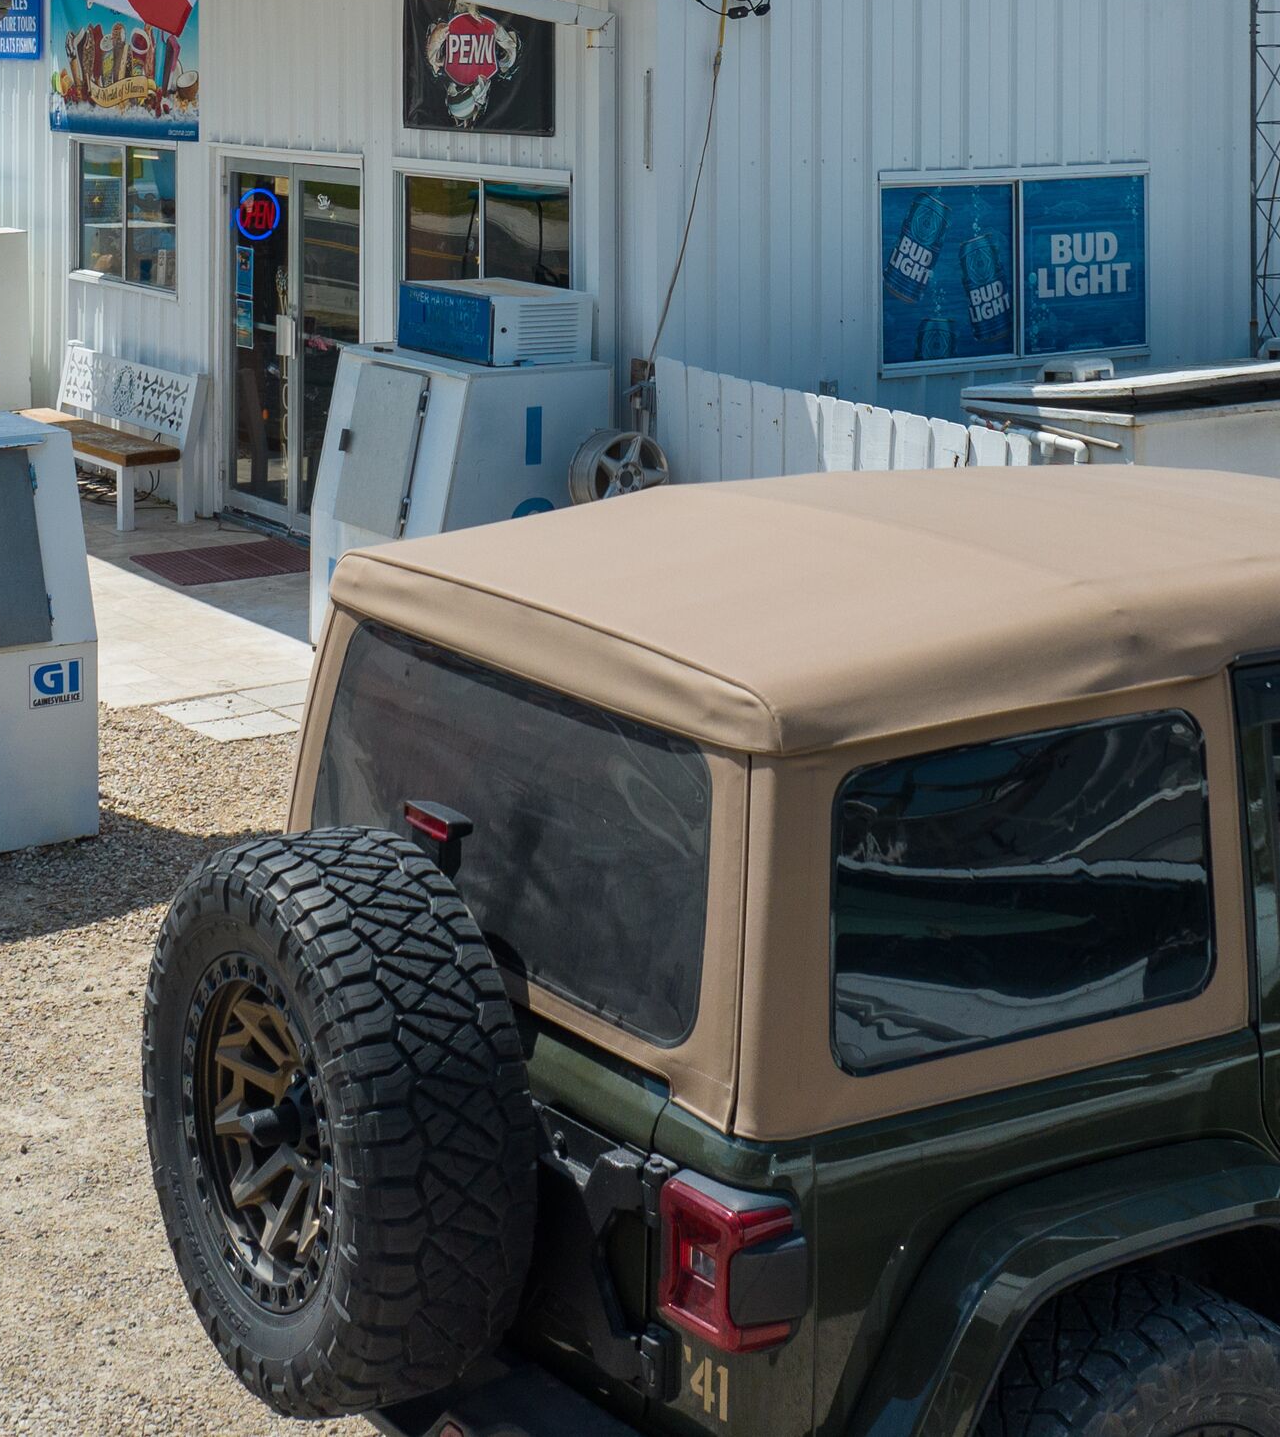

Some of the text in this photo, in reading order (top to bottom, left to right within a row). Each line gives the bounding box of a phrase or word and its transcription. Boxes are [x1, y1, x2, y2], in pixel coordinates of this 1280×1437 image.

[17, 16, 37, 32] TOURS
[0, 38, 16, 53] FLATS
[16, 38, 37, 54] FISHING
[448, 33, 494, 65] PENN
[239, 199, 276, 230] OPEN
[899, 235, 933, 267] BUD
[1050, 231, 1119, 265] BUD
[889, 247, 934, 284] LIGHT
[1037, 262, 1132, 299] LIGHT
[968, 293, 1011, 323] LIGHT
[969, 280, 1004, 306] BUD
[33, 660, 79, 695] GI
[33, 692, 81, 707] GAINESVILLE ICE
